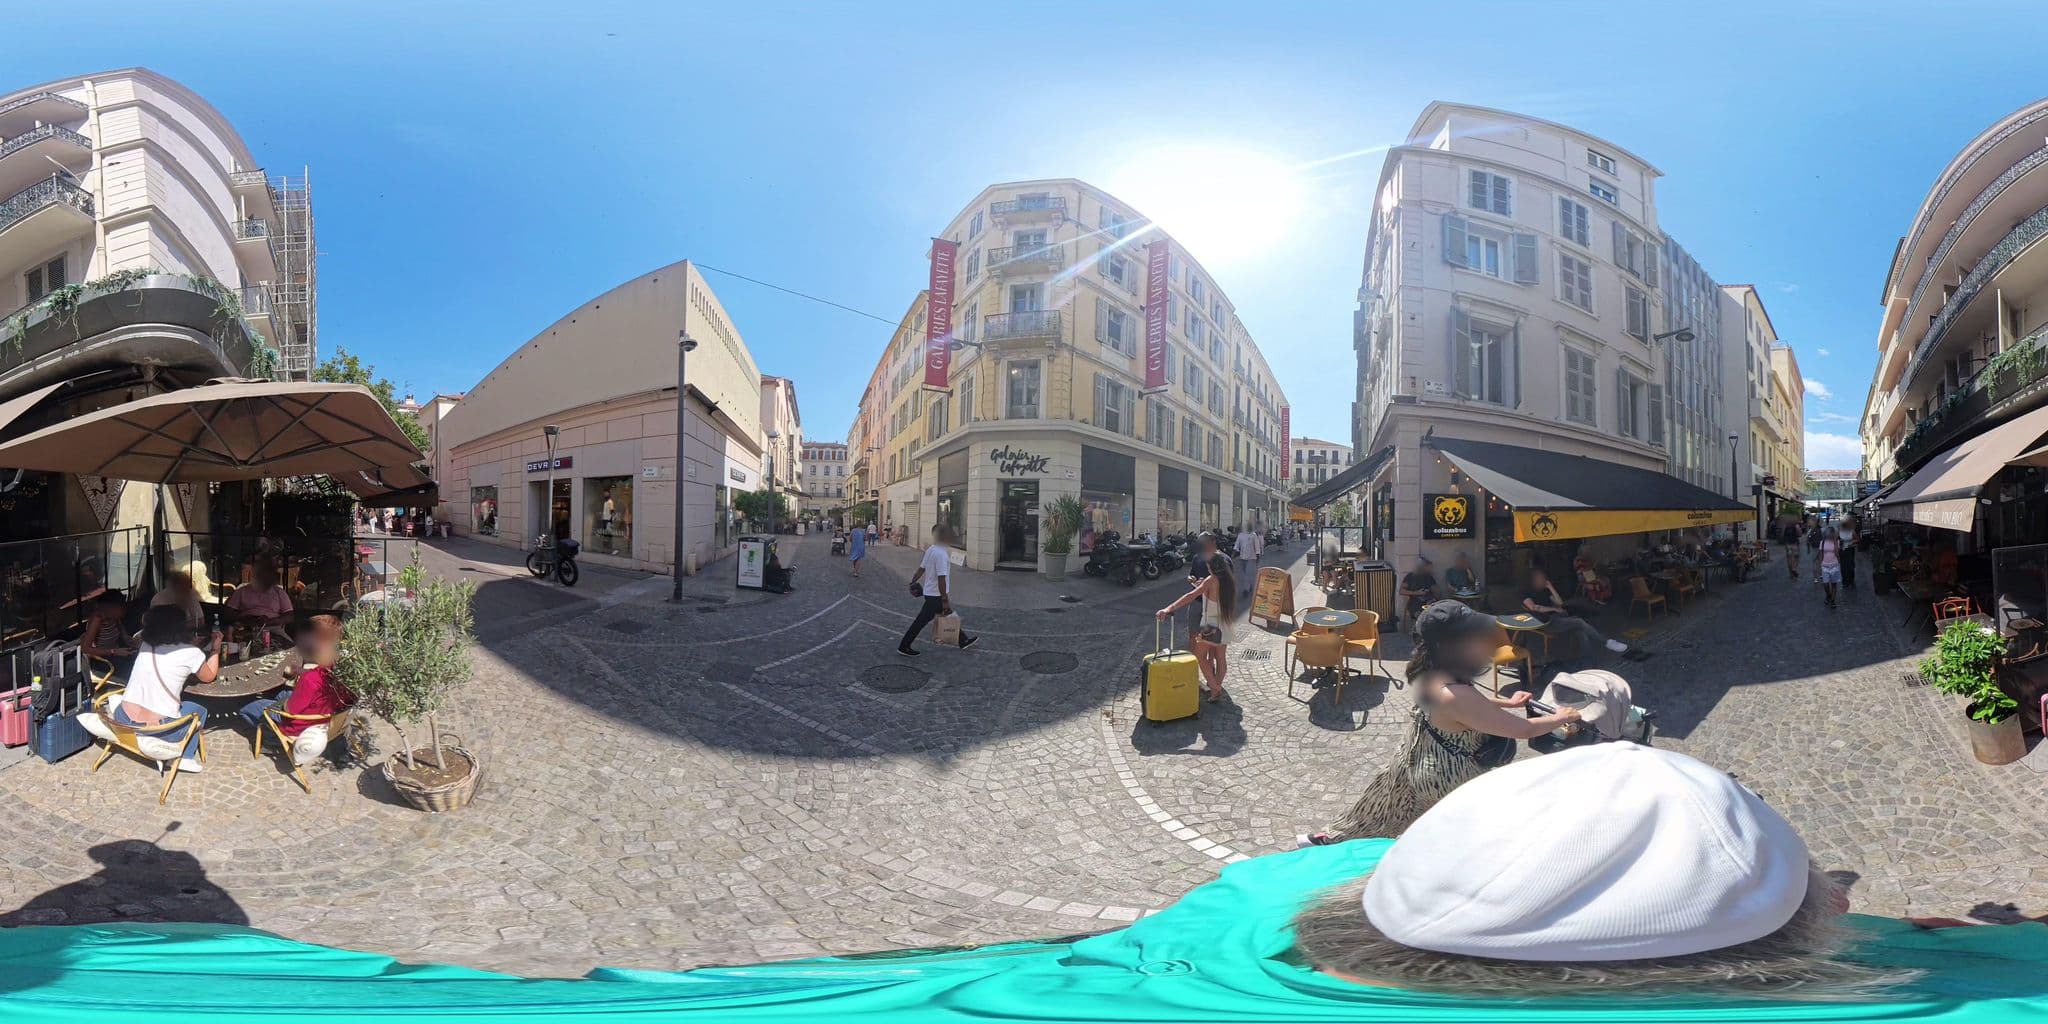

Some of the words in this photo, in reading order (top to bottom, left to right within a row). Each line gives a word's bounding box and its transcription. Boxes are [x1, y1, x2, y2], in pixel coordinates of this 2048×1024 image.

[934, 249, 950, 305] LAFAYETTE
[1151, 249, 1164, 305] LAFAYETTE
[930, 307, 946, 370] GALERIES
[1149, 307, 1162, 371] GALERIES
[990, 444, 1030, 464] Galeries
[1000, 454, 1051, 476] Lafayette
[1687, 511, 1712, 520] columbus
